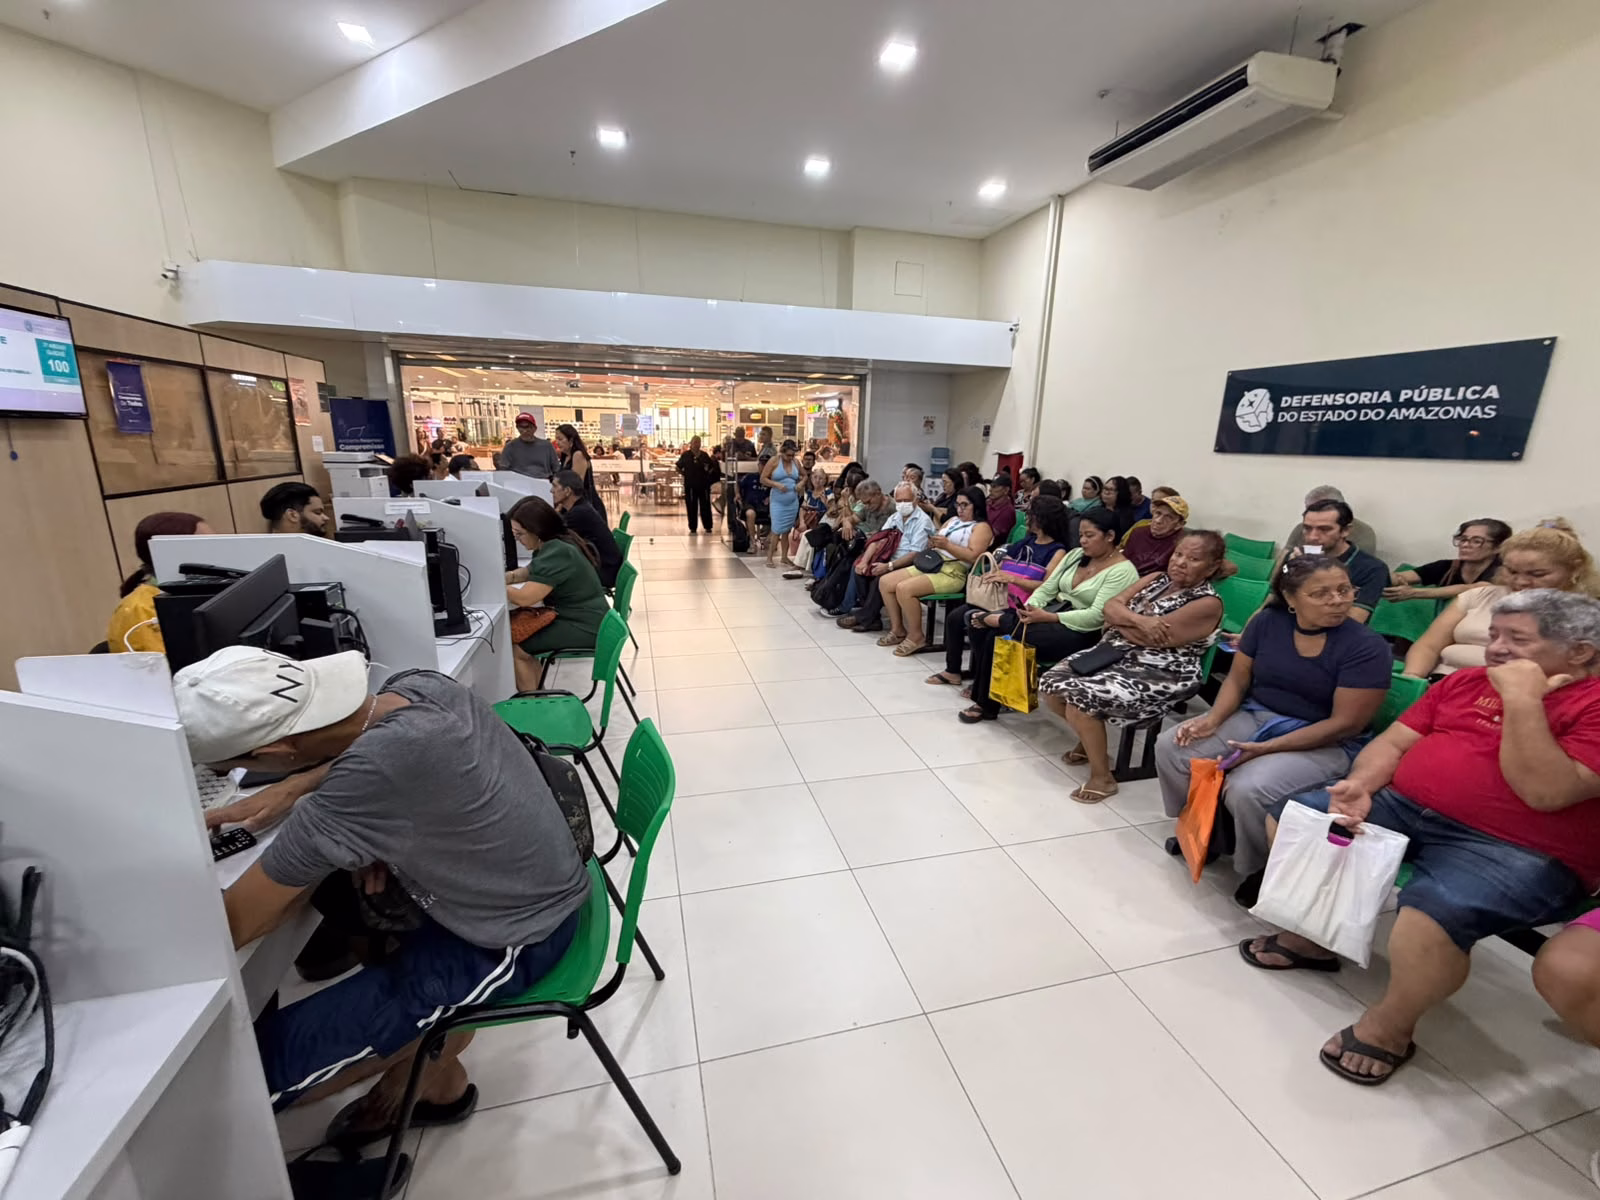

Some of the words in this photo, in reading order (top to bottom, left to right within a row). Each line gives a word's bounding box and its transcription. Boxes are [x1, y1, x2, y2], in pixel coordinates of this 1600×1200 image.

[48, 359, 70, 373] 100
[1280, 390, 1392, 408] DEFENSORIA
[1398, 385, 1500, 402] PÚBLICA
[1277, 411, 1298, 423] DO
[1299, 409, 1358, 422] ESTADO
[1360, 408, 1386, 420] DO
[1387, 405, 1497, 420] AMAZONAS
